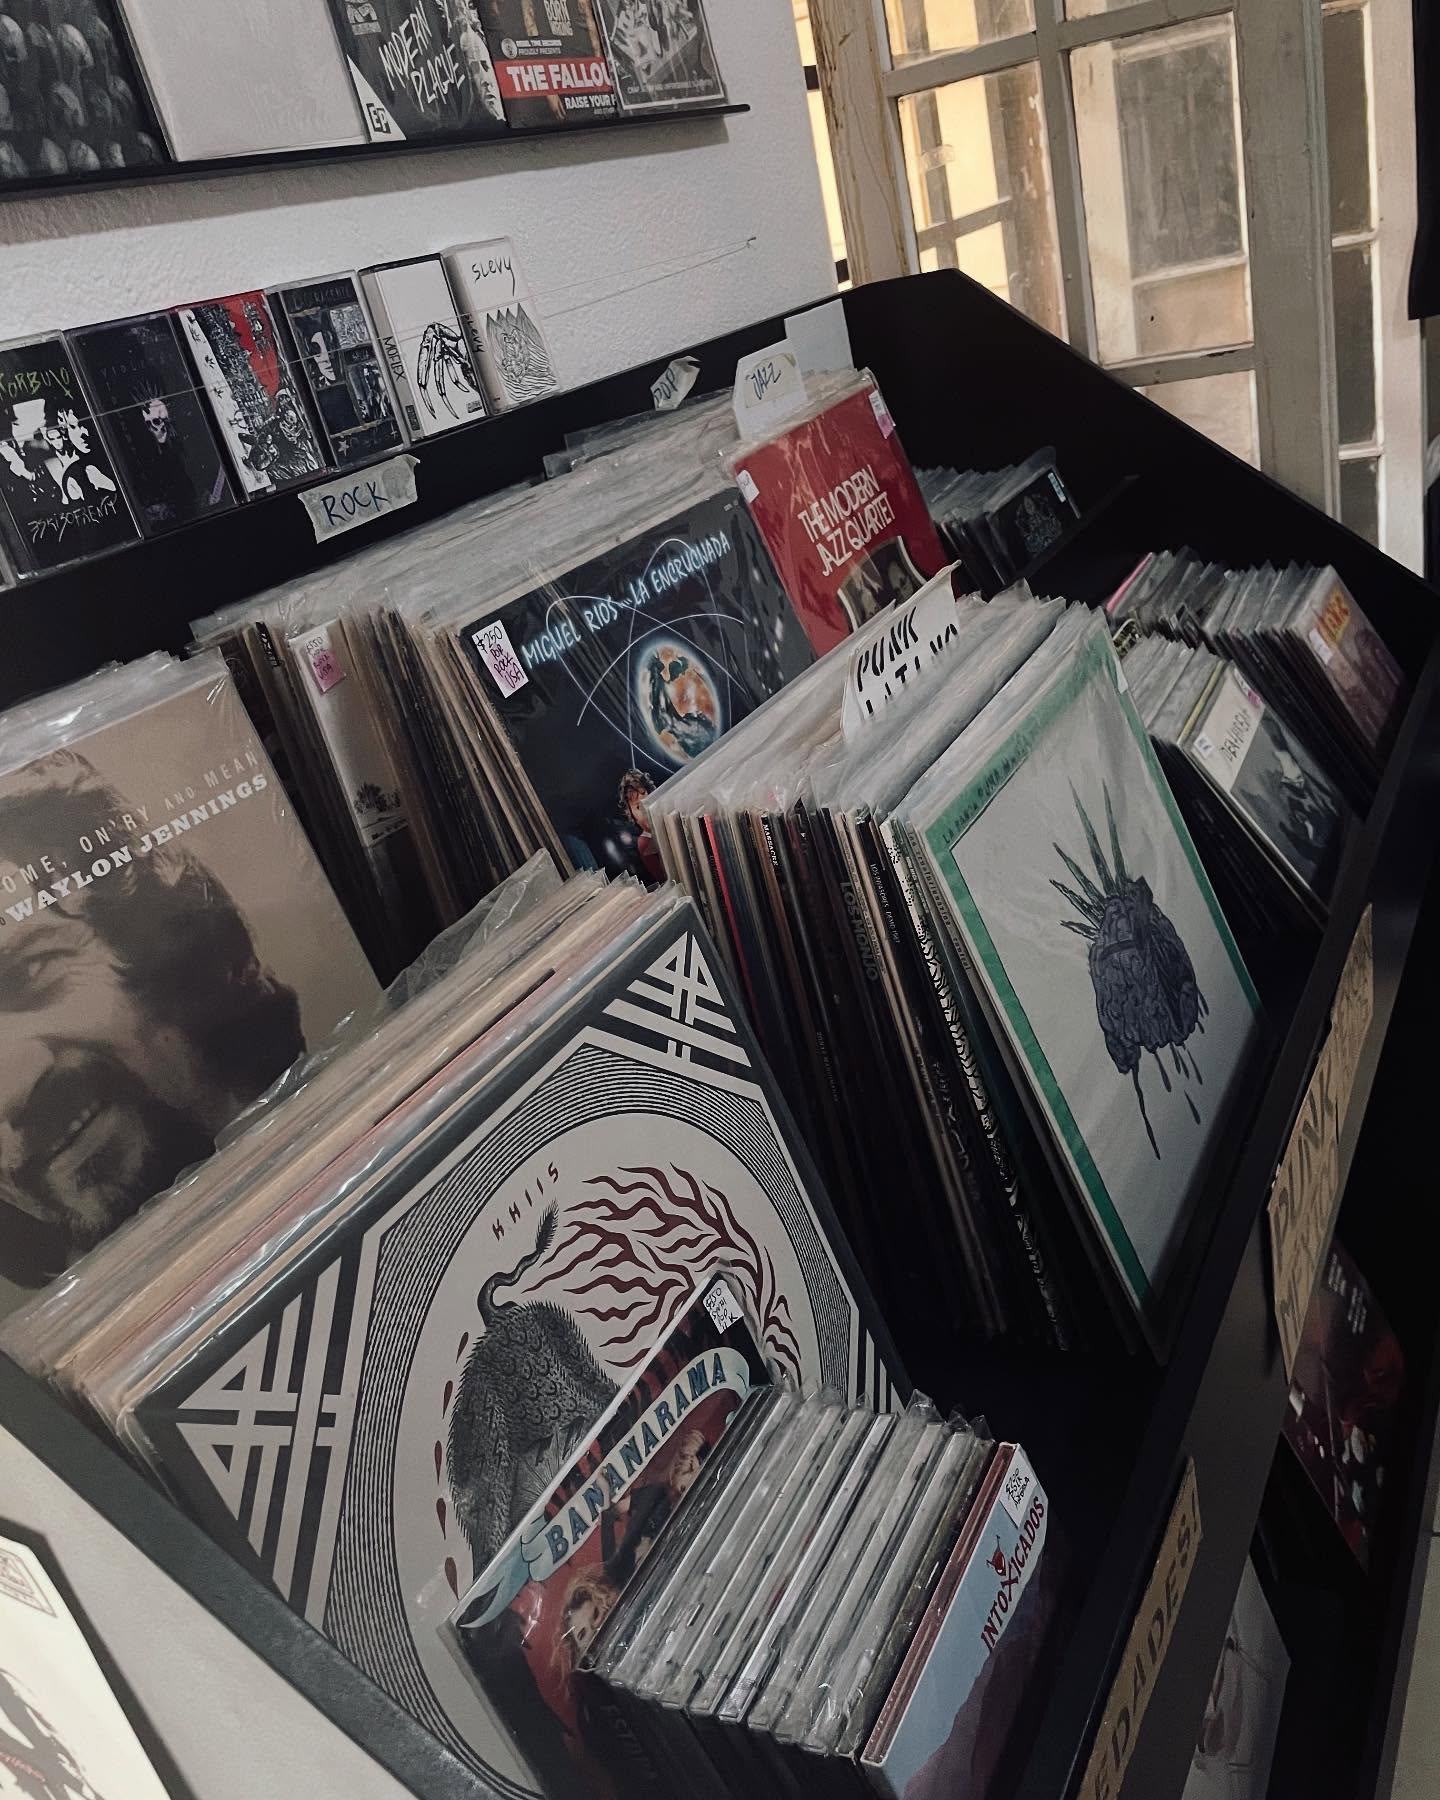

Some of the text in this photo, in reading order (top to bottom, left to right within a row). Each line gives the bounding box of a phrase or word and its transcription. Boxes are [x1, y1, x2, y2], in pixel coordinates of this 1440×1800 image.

[379, 0, 432, 91] MODERN
[410, 43, 465, 112] PLAGUE
[506, 65, 549, 92] THE
[564, 97, 589, 109] RAISE
[654, 367, 678, 408] POP
[749, 362, 782, 400] JAZZ
[321, 482, 388, 525] ROCK
[798, 464, 880, 543] THE MODERN
[816, 491, 895, 577] JAZZ QUARTET
[476, 625, 502, 654] $250
[520, 617, 582, 671] MIGUEL
[628, 580, 650, 608] LA
[857, 606, 918, 692] PUNK
[505, 662, 524, 688] USA
[164, 785, 196, 811] AND
[204, 750, 260, 788] MEAN
[6, 773, 269, 924] WAYLON JENNINGS
[1275, 1052, 1333, 1268] PUNK
[1281, 1140, 1337, 1356] MEXICO
[545, 1351, 727, 1565] BANANARAMA
[980, 1495, 1046, 1652] INTOXICADOS
